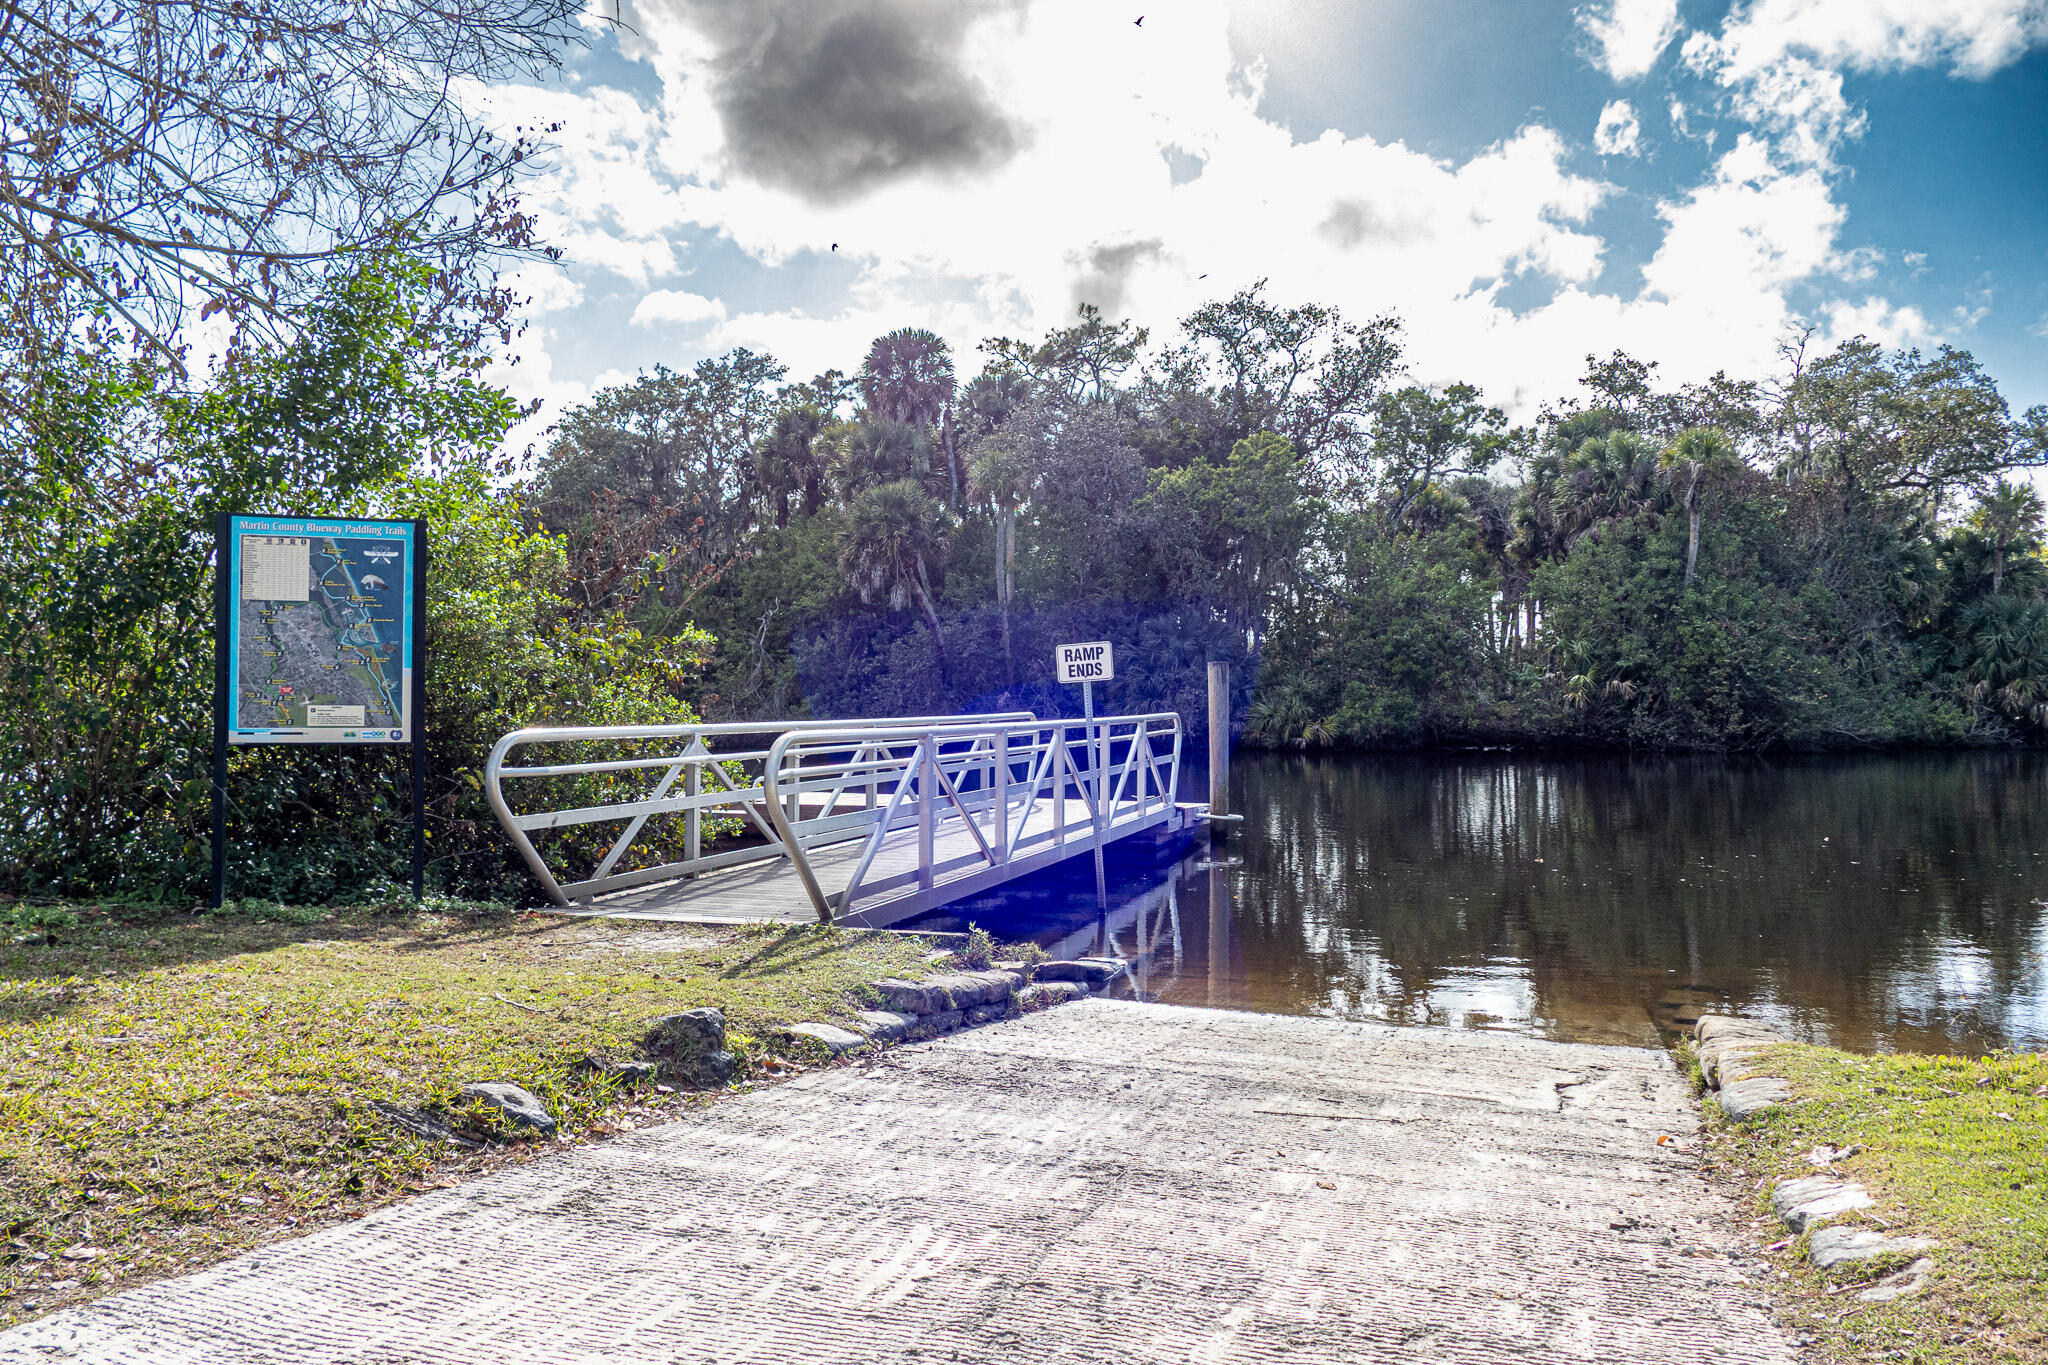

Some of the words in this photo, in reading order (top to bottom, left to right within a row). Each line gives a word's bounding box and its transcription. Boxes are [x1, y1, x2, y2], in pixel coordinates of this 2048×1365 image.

[240, 520, 270, 530] Martin
[272, 522, 304, 534] County
[307, 524, 343, 535] Blueway
[346, 525, 382, 536] Paddling
[384, 526, 407, 536] Trails
[1064, 646, 1104, 662] RAMP
[1068, 662, 1103, 678] ENDS
